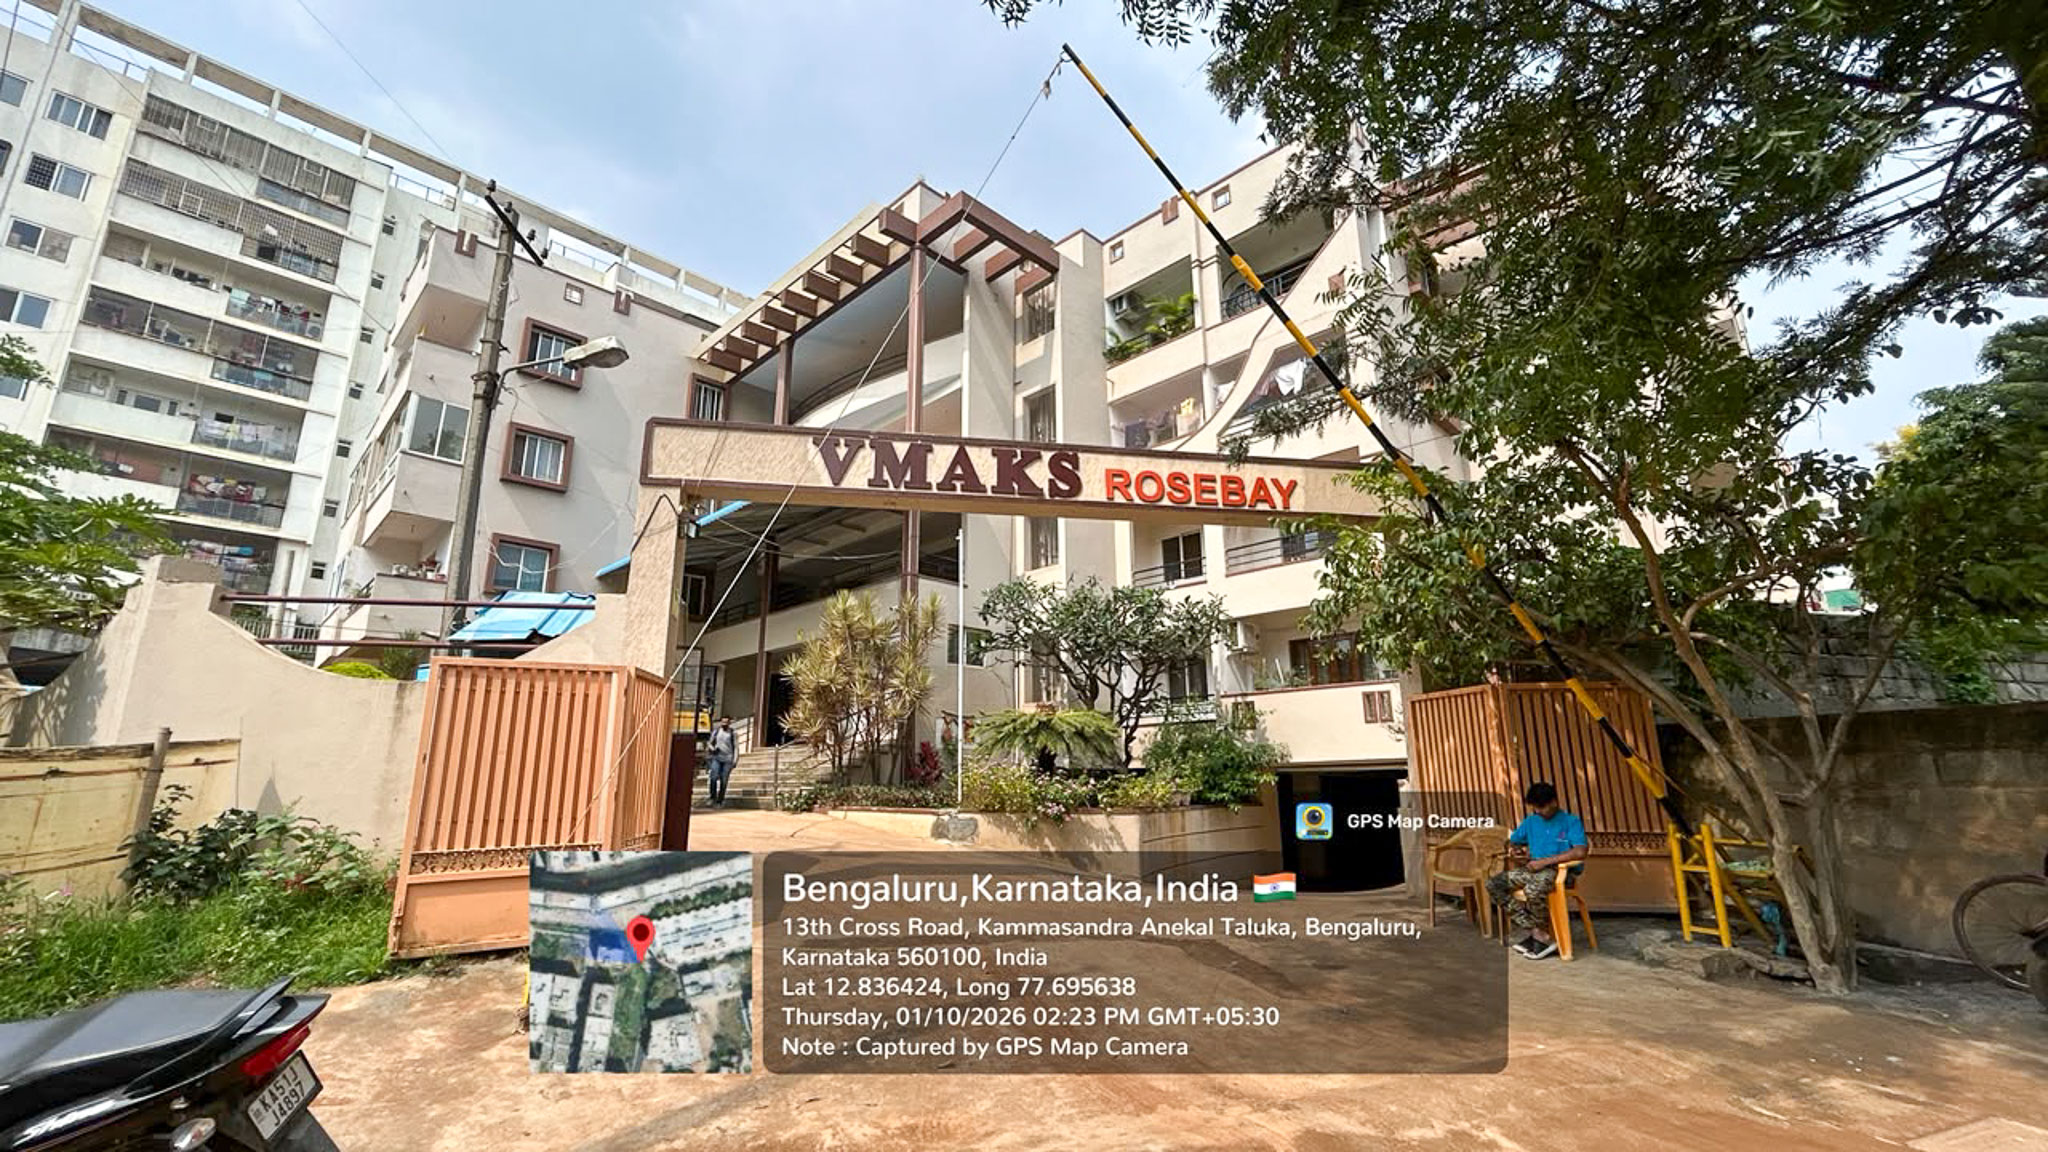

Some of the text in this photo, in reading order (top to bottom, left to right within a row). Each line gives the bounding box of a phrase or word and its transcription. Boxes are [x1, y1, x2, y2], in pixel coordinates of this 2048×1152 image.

[812, 437, 1298, 510] VMAKS ROSEBAY
[272, 1079, 305, 1127] J4897
